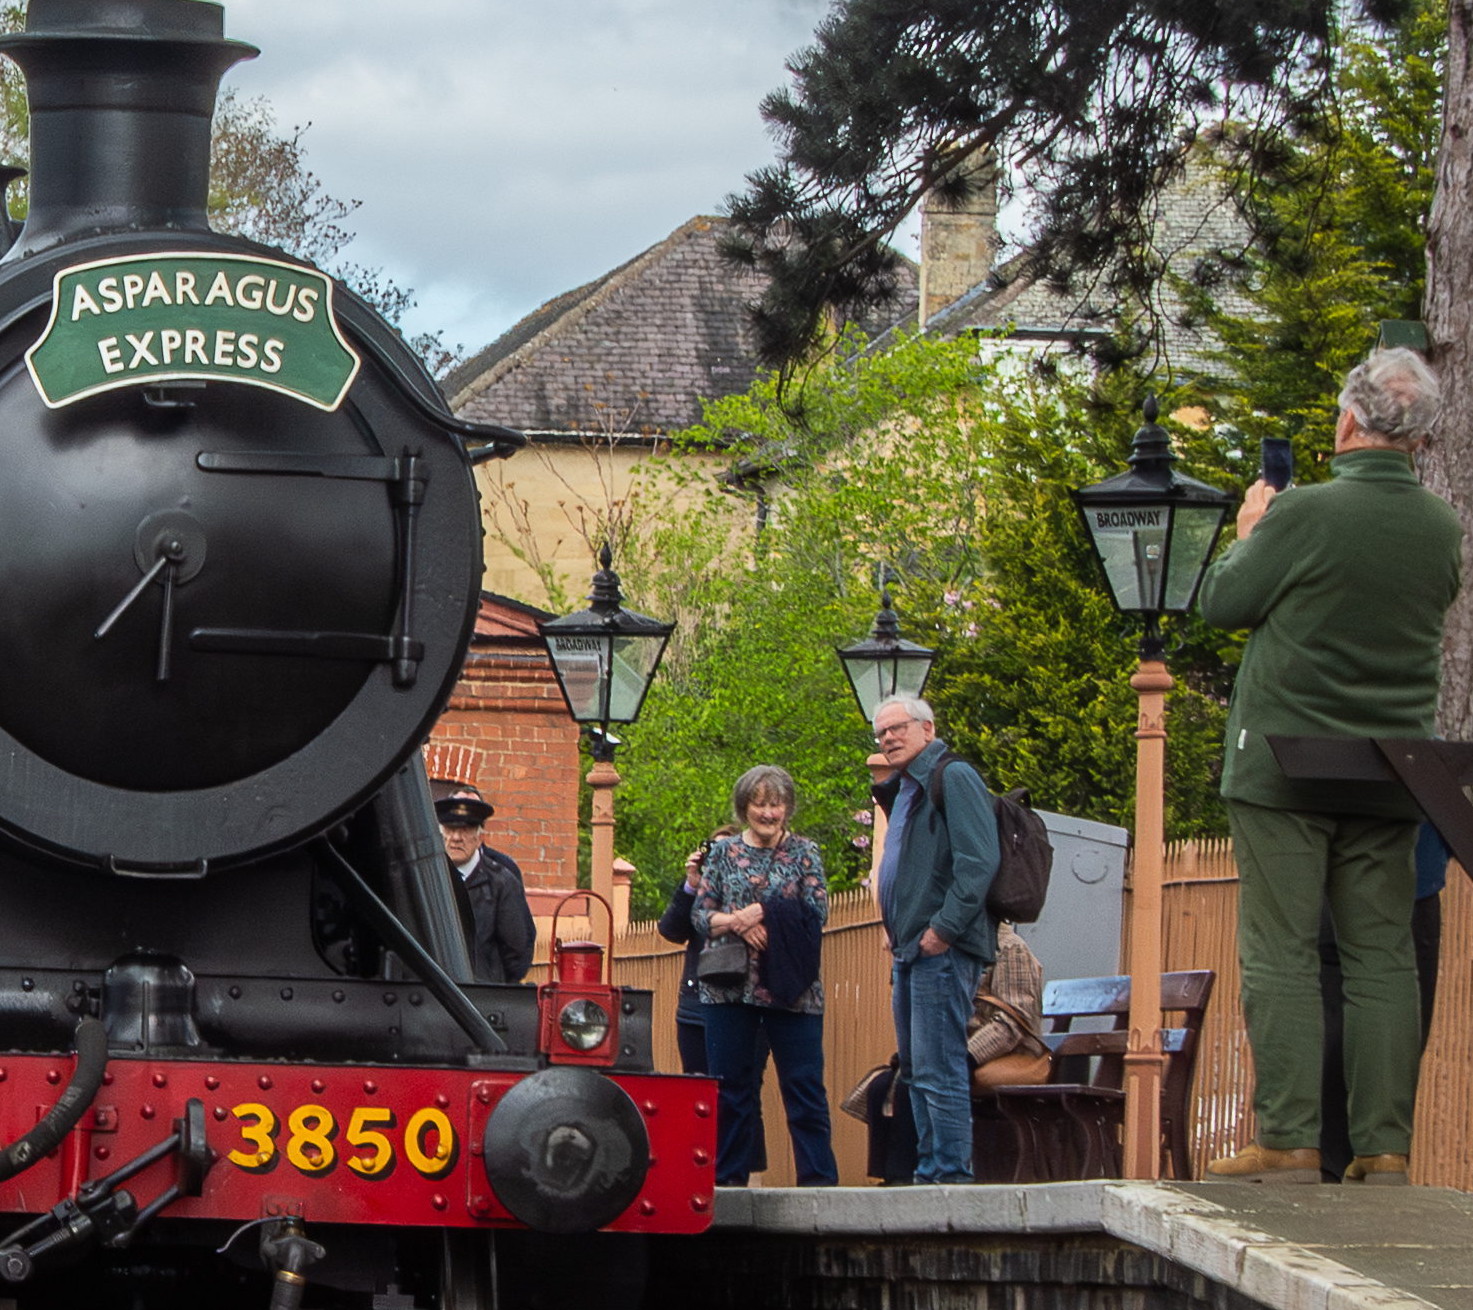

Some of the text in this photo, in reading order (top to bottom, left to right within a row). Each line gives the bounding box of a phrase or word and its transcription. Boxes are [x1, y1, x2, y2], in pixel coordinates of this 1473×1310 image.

[71, 271, 319, 323] ASPARAGUS
[97, 328, 285, 374] EXPRESS
[1096, 510, 1160, 528] BROADWAY
[555, 637, 602, 652] BROADWAY
[227, 1102, 455, 1177] 3850
